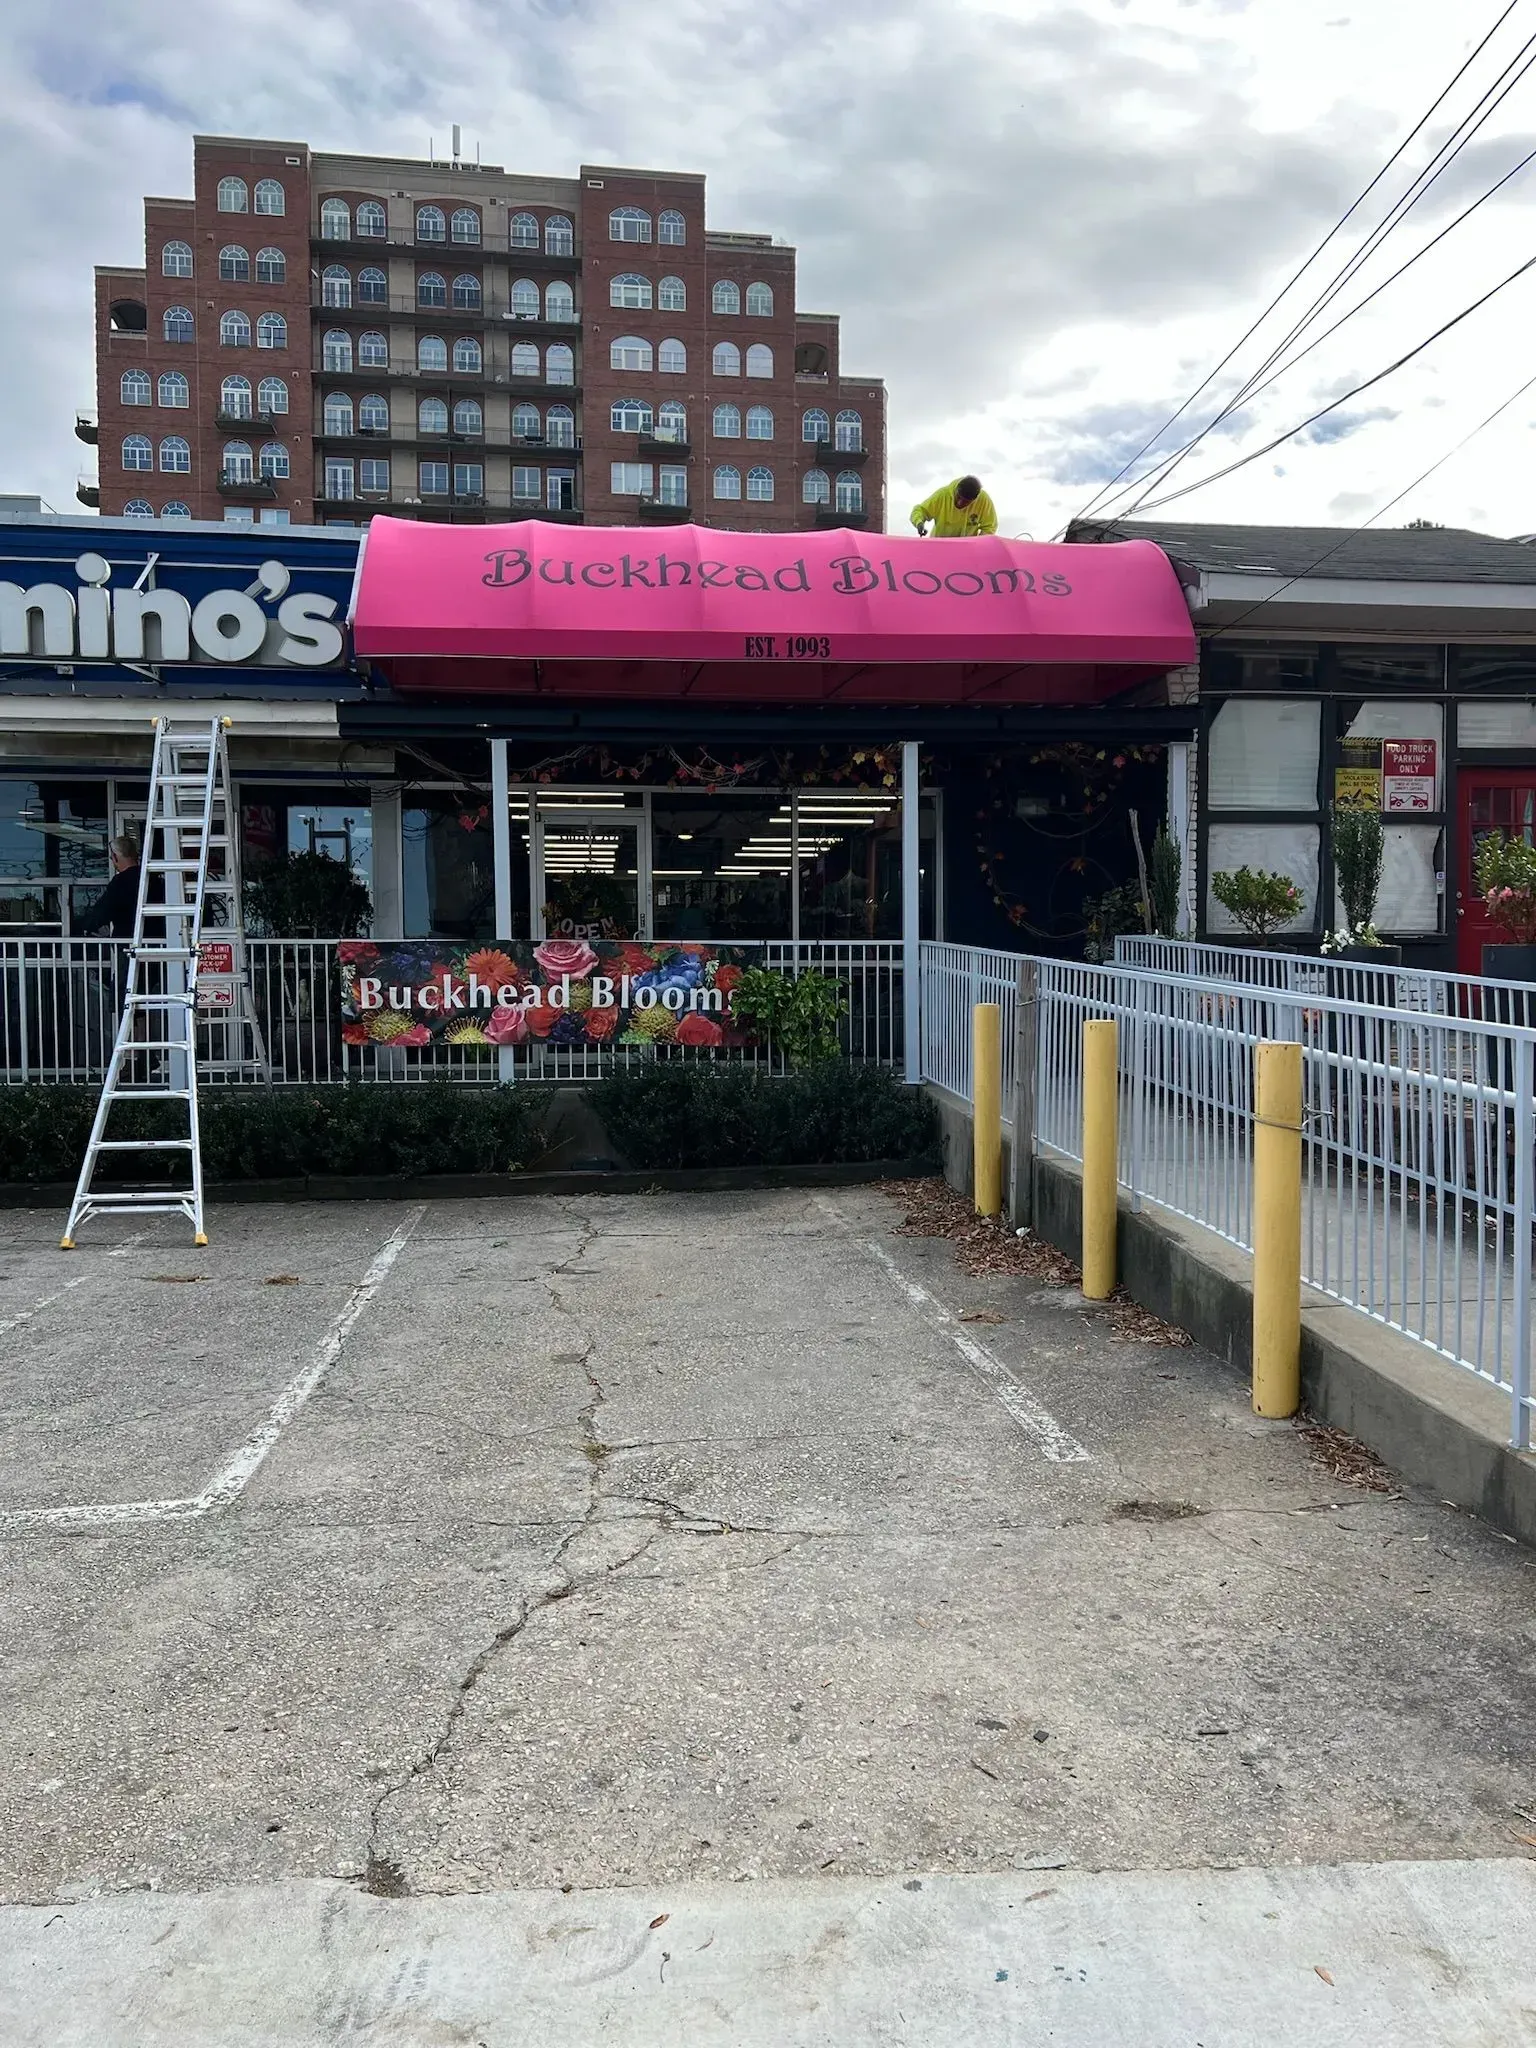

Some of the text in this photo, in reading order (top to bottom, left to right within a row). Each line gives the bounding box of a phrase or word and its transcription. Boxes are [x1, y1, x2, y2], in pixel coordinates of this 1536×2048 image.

[482, 548, 1074, 597] Buckhead Blooms
[744, 636, 830, 659] EST. 1993
[1386, 744, 1406, 753] FOOD
[1408, 744, 1434, 753] TRUCK
[1393, 754, 1426, 763] PARKING
[1399, 764, 1420, 773] ONLY
[560, 916, 614, 940] OPEN
[360, 973, 570, 1009] Buckhead
